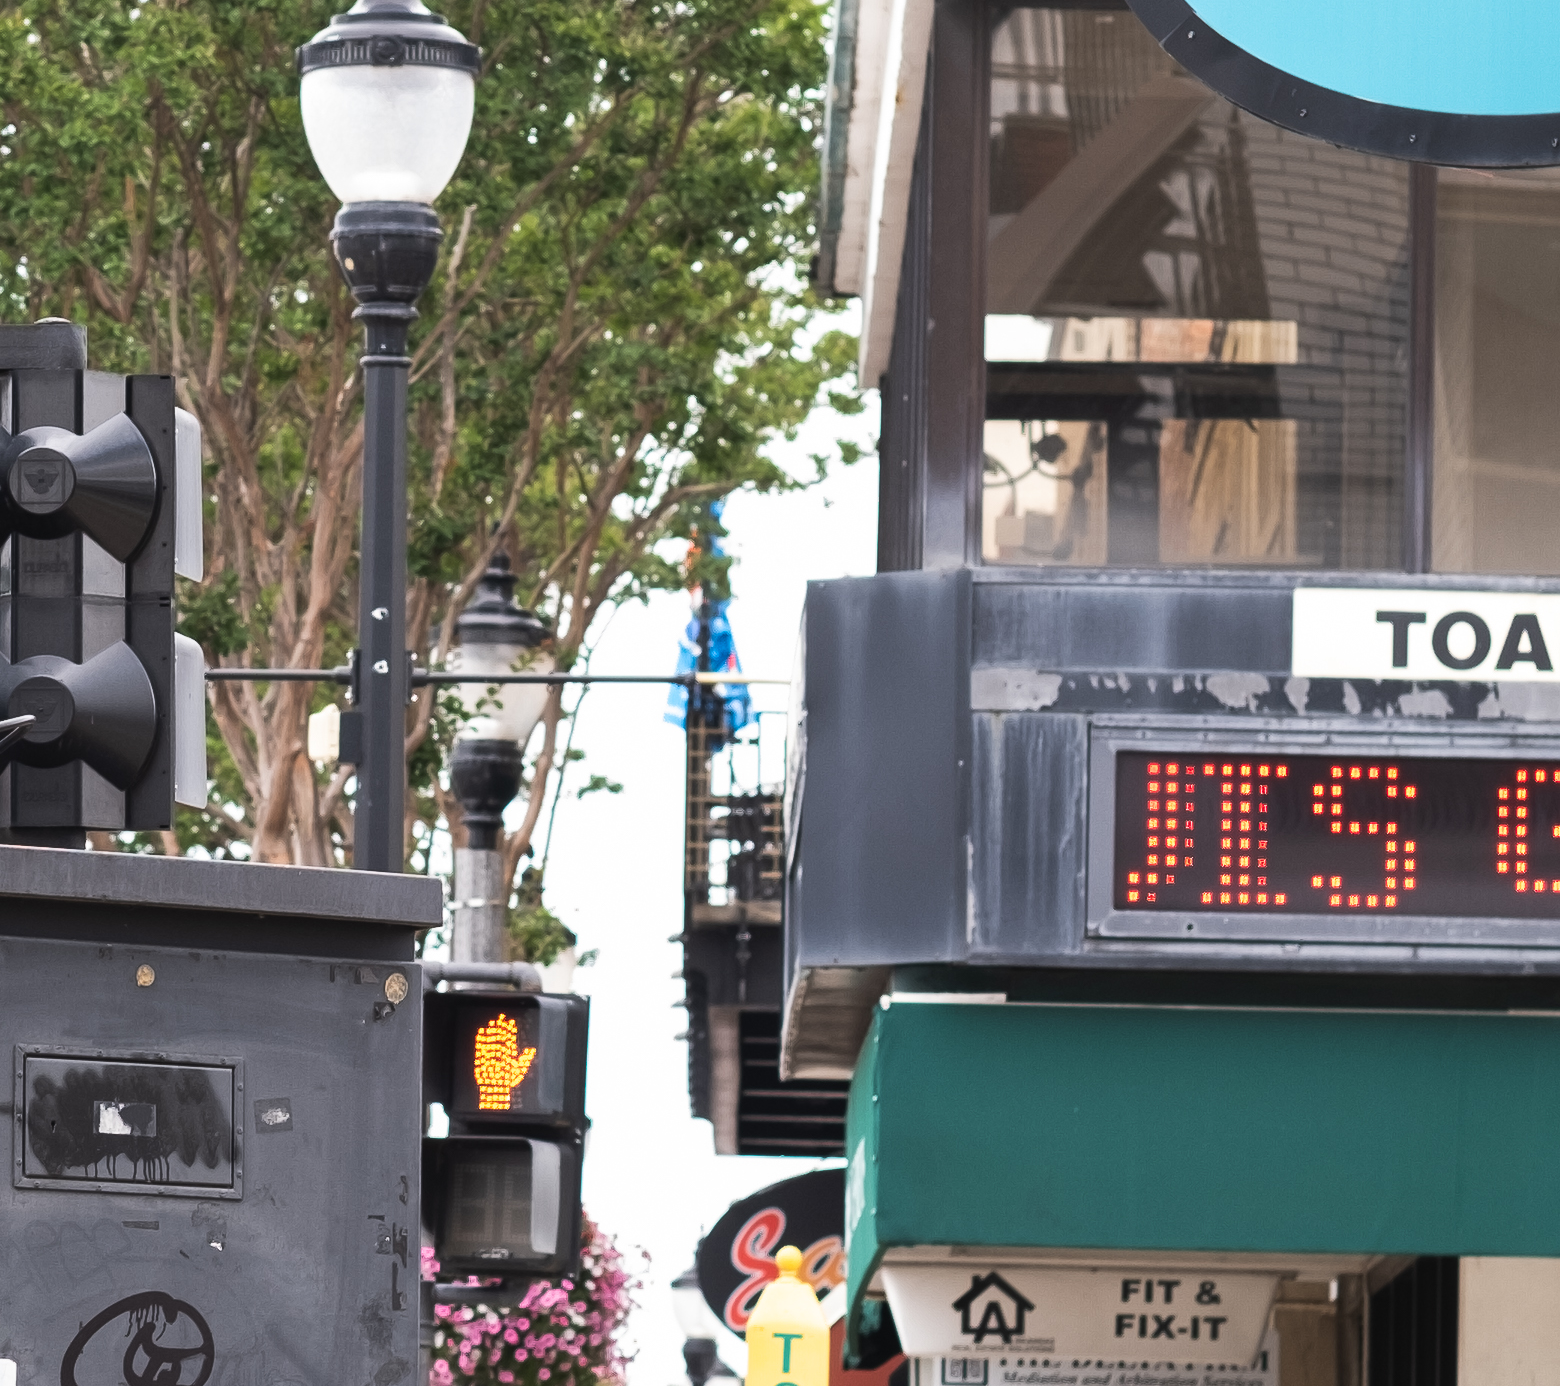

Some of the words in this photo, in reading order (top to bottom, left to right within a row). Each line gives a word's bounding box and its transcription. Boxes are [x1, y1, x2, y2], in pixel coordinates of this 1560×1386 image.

[1121, 1278, 1181, 1304] FIT
[1195, 1279, 1222, 1306] &
[1114, 1313, 1229, 1341] FIX-IT
